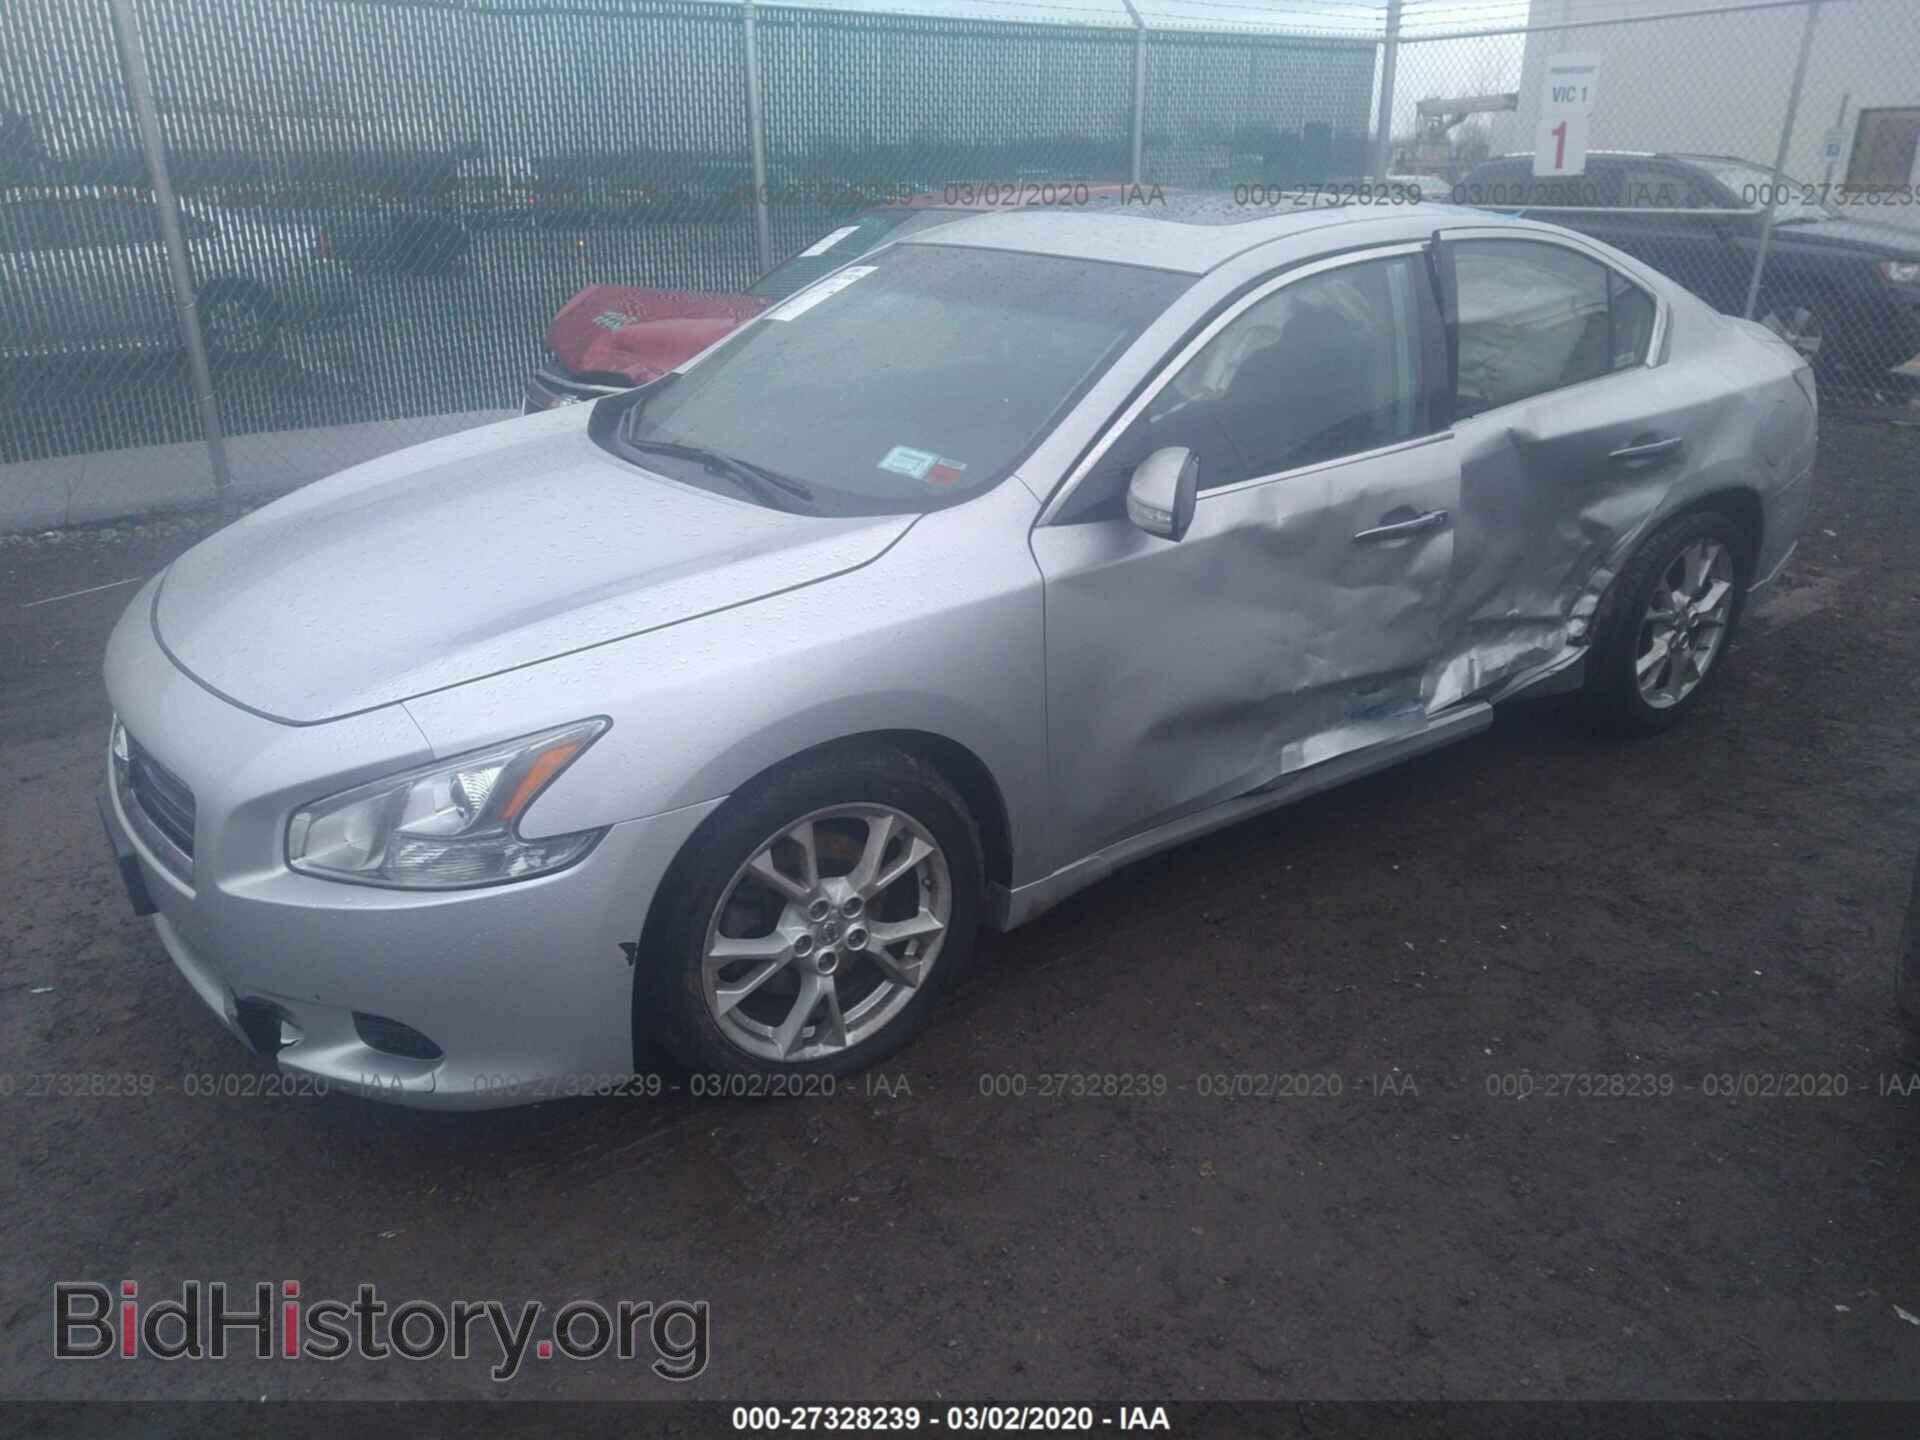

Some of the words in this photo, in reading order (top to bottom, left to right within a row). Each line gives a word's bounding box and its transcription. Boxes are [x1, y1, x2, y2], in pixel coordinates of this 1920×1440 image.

[1552, 86, 1575, 102] VIC
[1581, 86, 1587, 102] 1
[1551, 121, 1567, 169] 1
